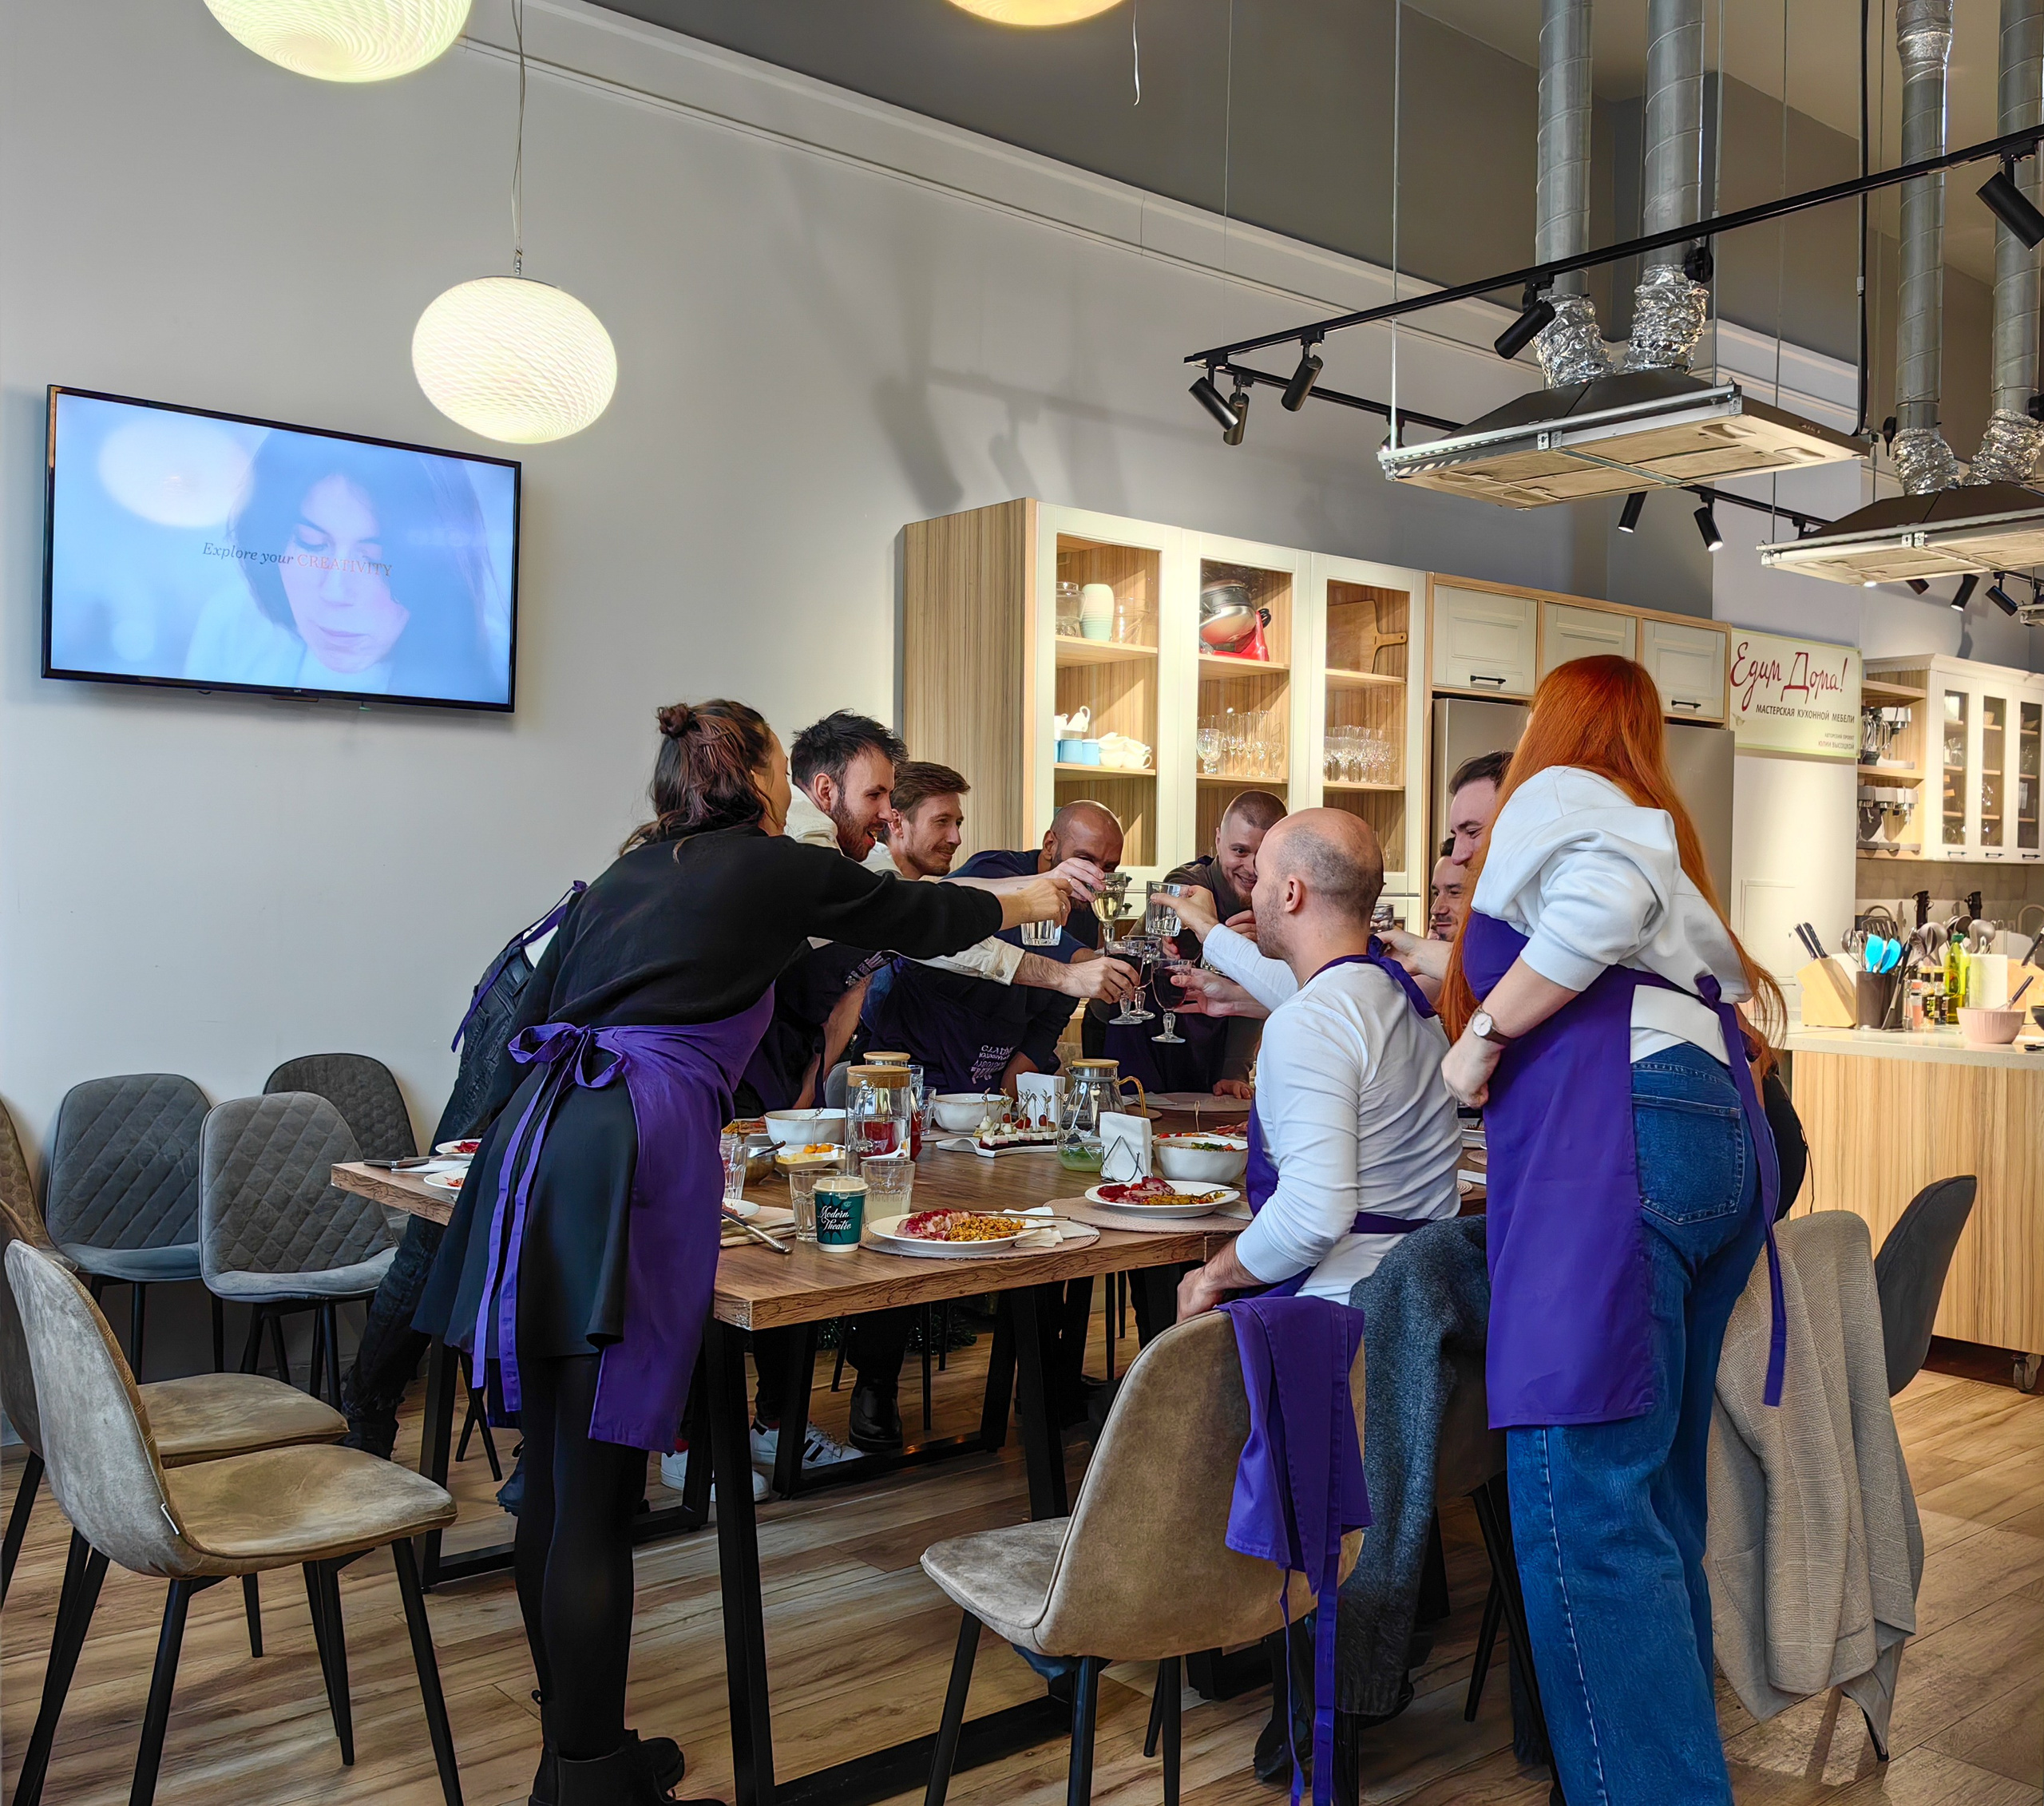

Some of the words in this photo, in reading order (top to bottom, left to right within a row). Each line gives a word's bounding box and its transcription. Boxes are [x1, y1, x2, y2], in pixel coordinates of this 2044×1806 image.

[202, 542, 257, 560] Explore
[259, 552, 294, 564] your
[297, 553, 393, 576] CREATIVITY
[1730, 642, 1782, 712] Едим
[1781, 652, 1848, 704] Дома!
[1756, 704, 1795, 717] МАСТЕРСКАЯ
[1796, 708, 1830, 721] КУХОННОЙ
[1832, 713, 1855, 723] МЕБЕЛИ
[817, 1206, 850, 1219] Modern
[821, 1217, 852, 1230] Theatre
